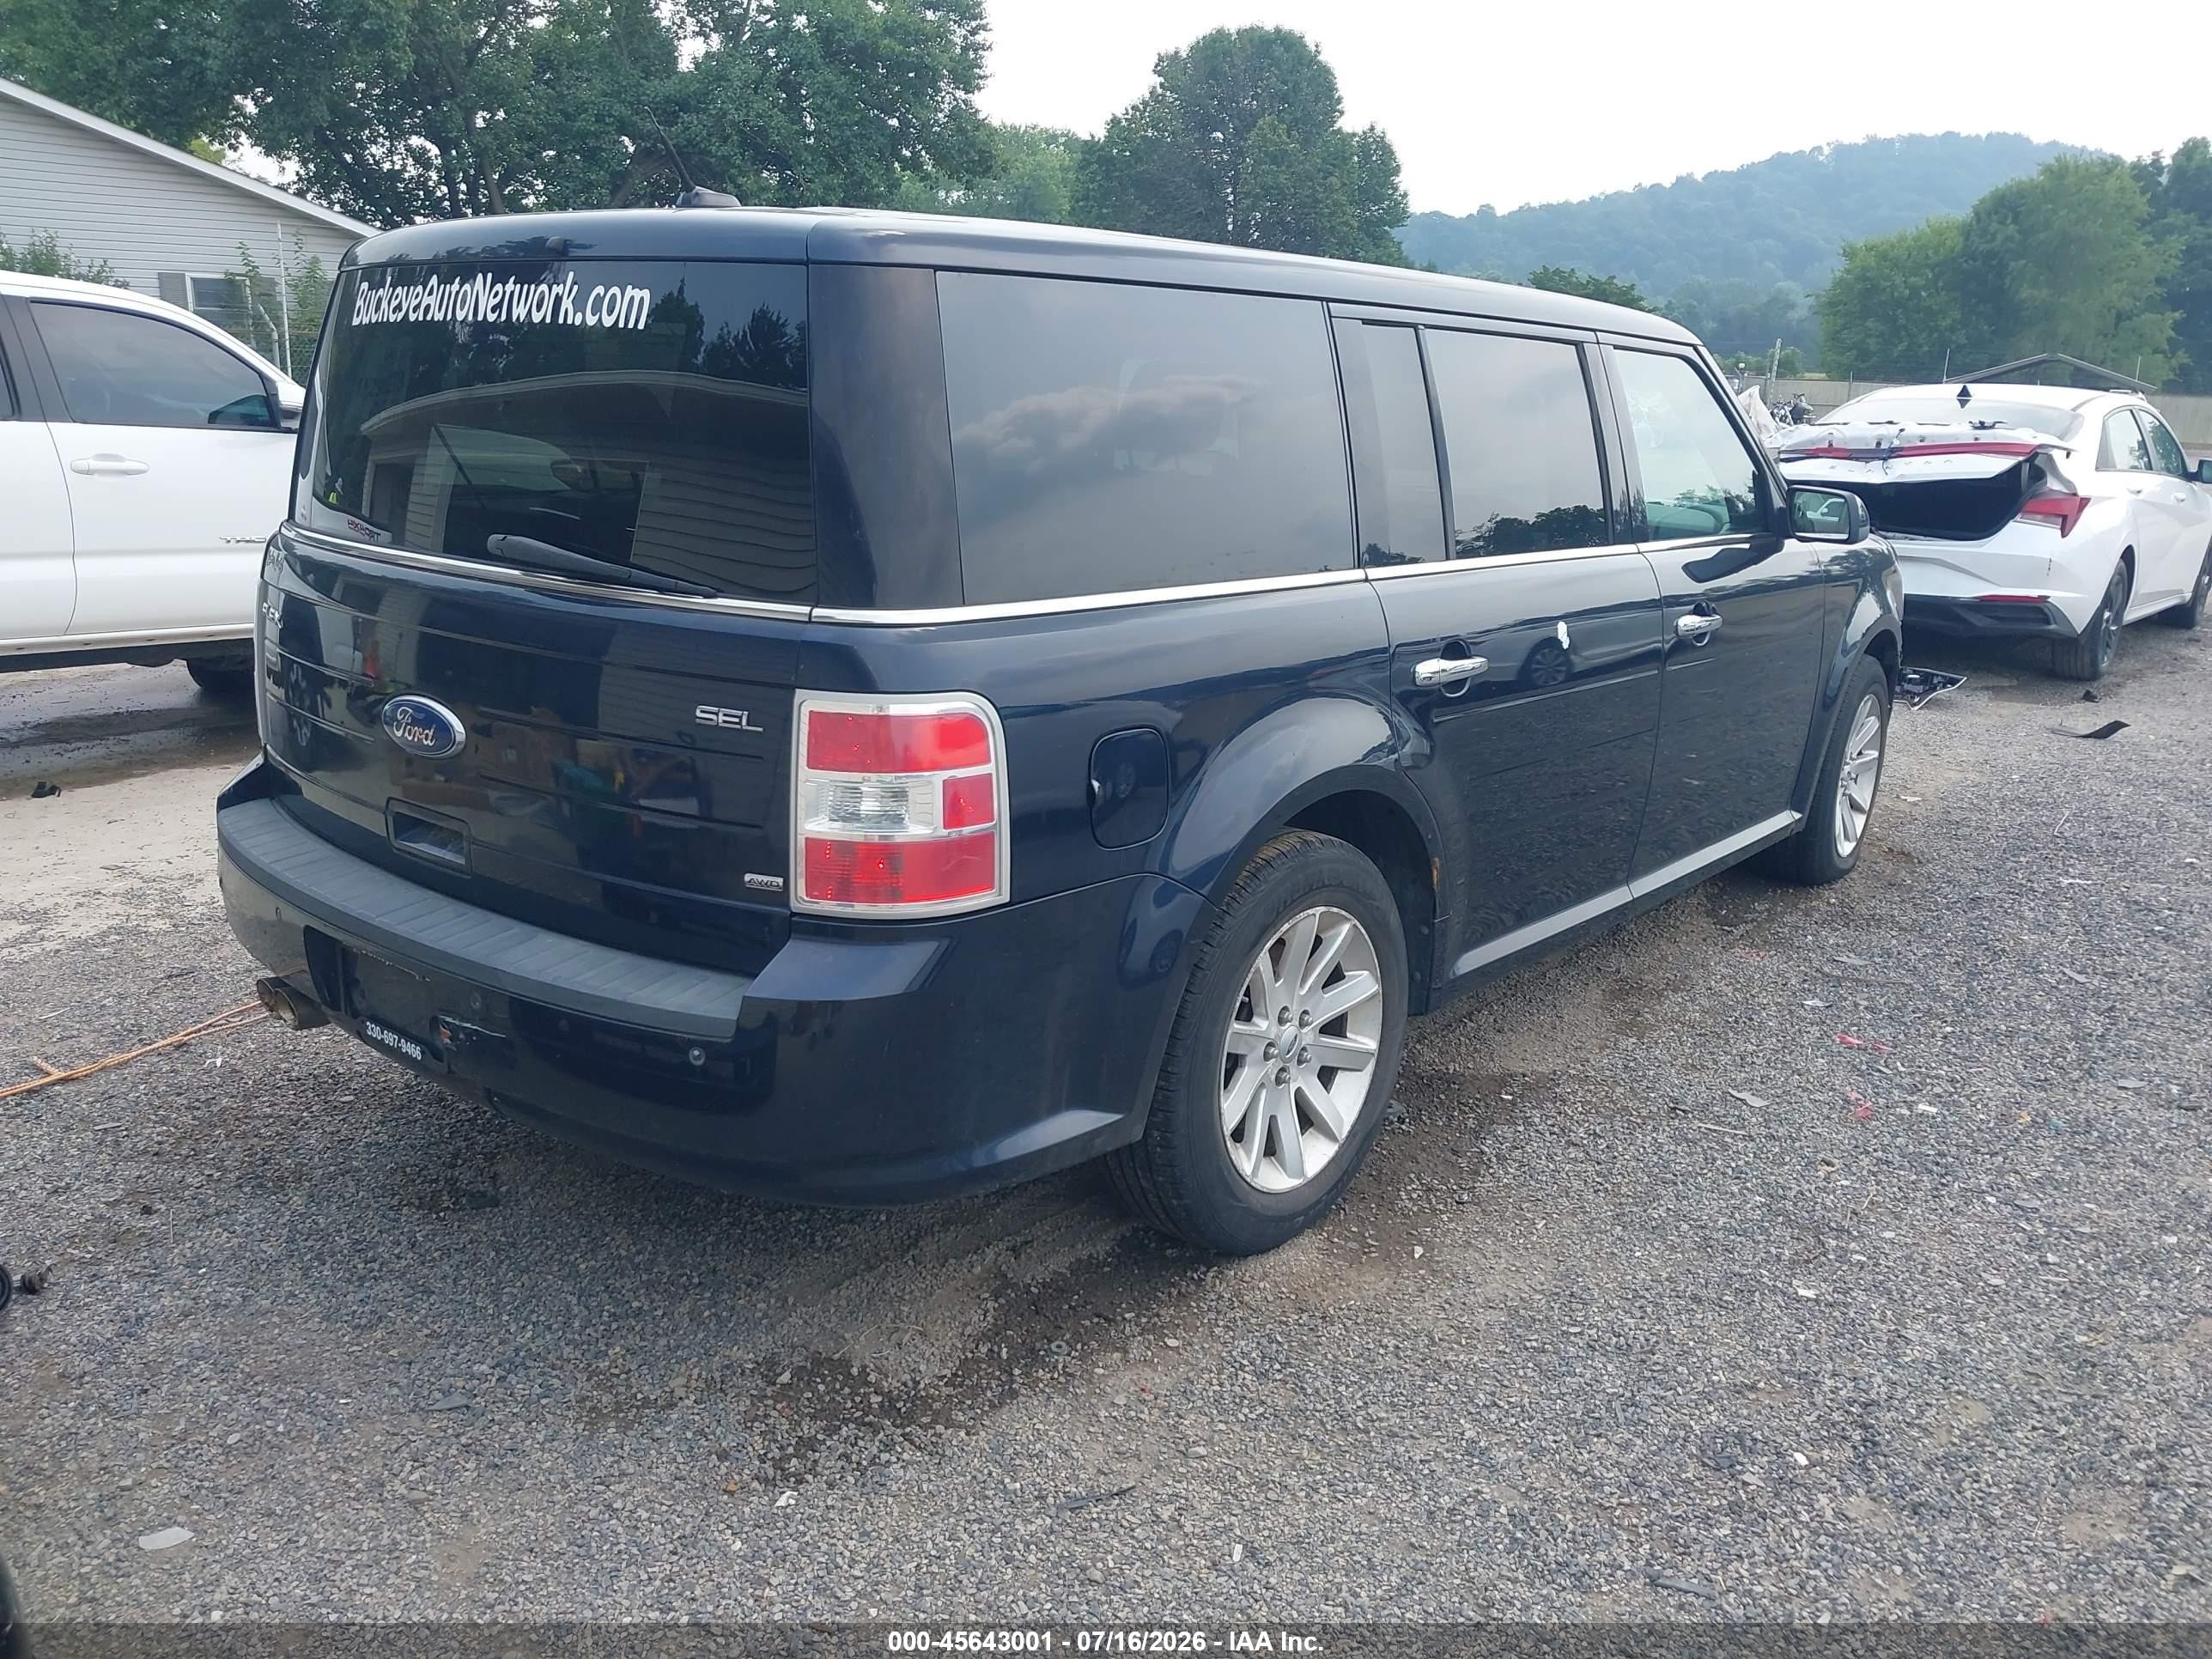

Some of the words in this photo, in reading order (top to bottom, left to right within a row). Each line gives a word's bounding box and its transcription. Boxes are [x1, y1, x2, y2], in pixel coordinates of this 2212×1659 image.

[352, 271, 651, 330] BuckeyeAutoNetwork.com
[393, 707, 435, 746] Ford
[696, 705, 763, 732] SEL
[747, 877, 781, 889] AWD
[366, 1021, 422, 1060] 330-697-9466
